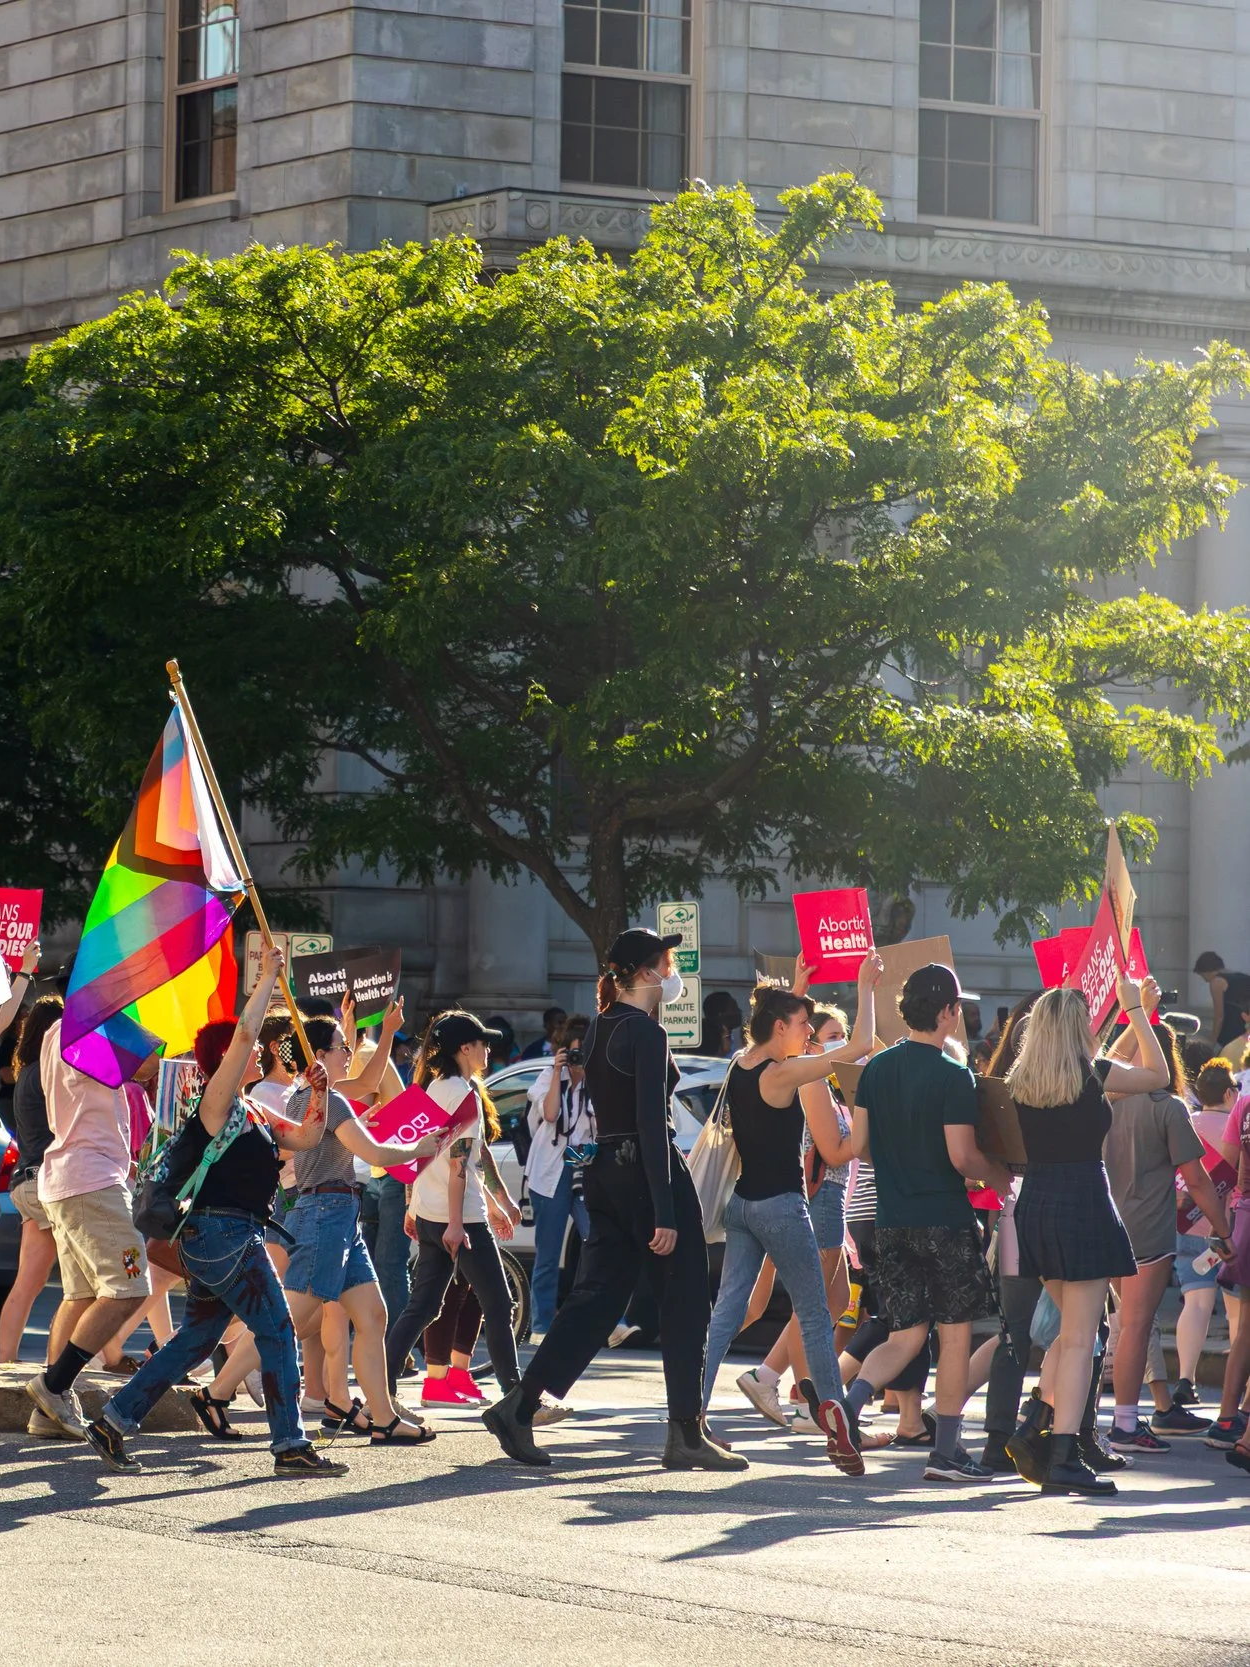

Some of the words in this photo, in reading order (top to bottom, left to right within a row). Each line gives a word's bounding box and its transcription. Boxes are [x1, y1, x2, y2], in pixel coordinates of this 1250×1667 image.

[6, 921, 34, 940] OUR
[663, 926, 694, 935] ELECTRIC
[819, 933, 869, 951] Health
[1099, 935, 1115, 980] OUR
[1129, 956, 1136, 971] is
[308, 968, 347, 984] Aborti
[1081, 941, 1102, 994] BANS
[309, 981, 348, 997] Health
[353, 973, 386, 990] Abortion
[386, 971, 393, 982] is
[1089, 957, 1117, 1020] ODIES
[354, 986, 380, 1003] Health
[380, 985, 395, 997] Care
[665, 1003, 695, 1012] MINUTE
[663, 1016, 697, 1025] PARKING
